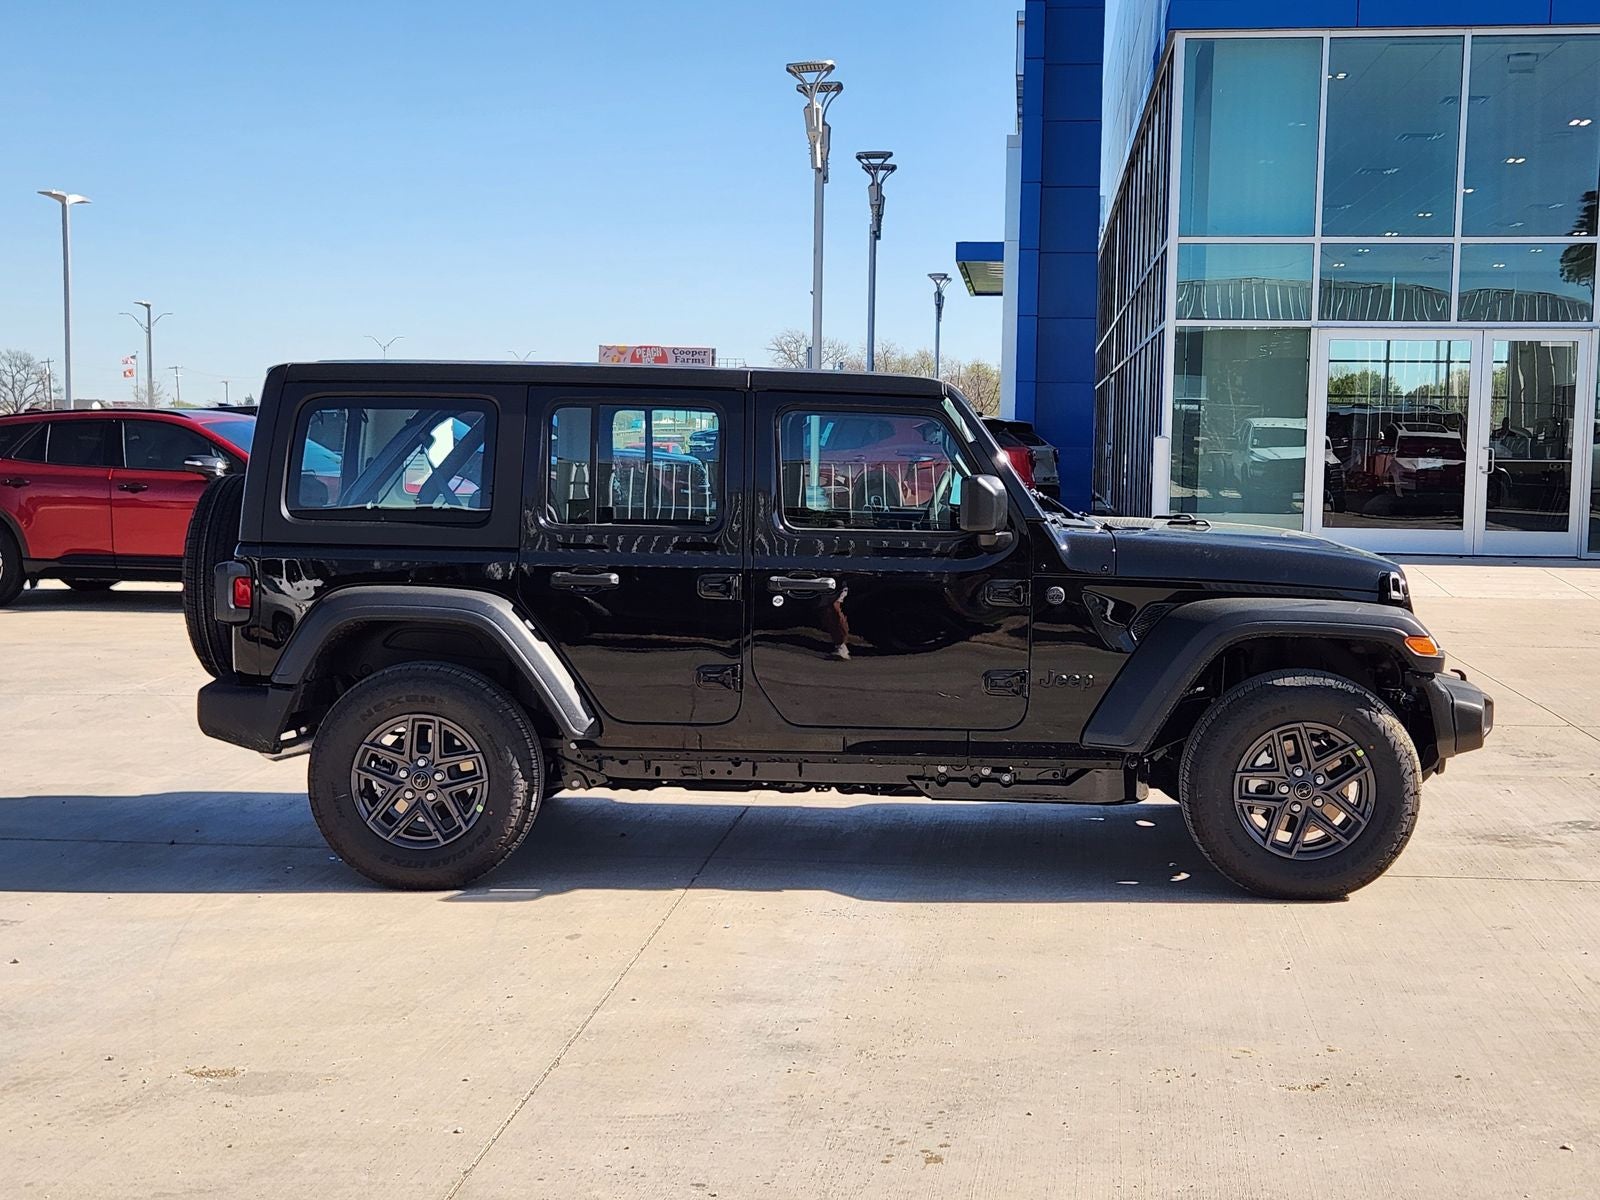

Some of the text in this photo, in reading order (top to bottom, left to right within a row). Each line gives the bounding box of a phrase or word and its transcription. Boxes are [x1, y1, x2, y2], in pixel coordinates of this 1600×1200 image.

[635, 347, 662, 359] PEACH
[672, 347, 708, 357] Cooper
[674, 356, 705, 364] Farms
[1039, 668, 1095, 692] Jeep
[360, 694, 436, 722] NEXEN
